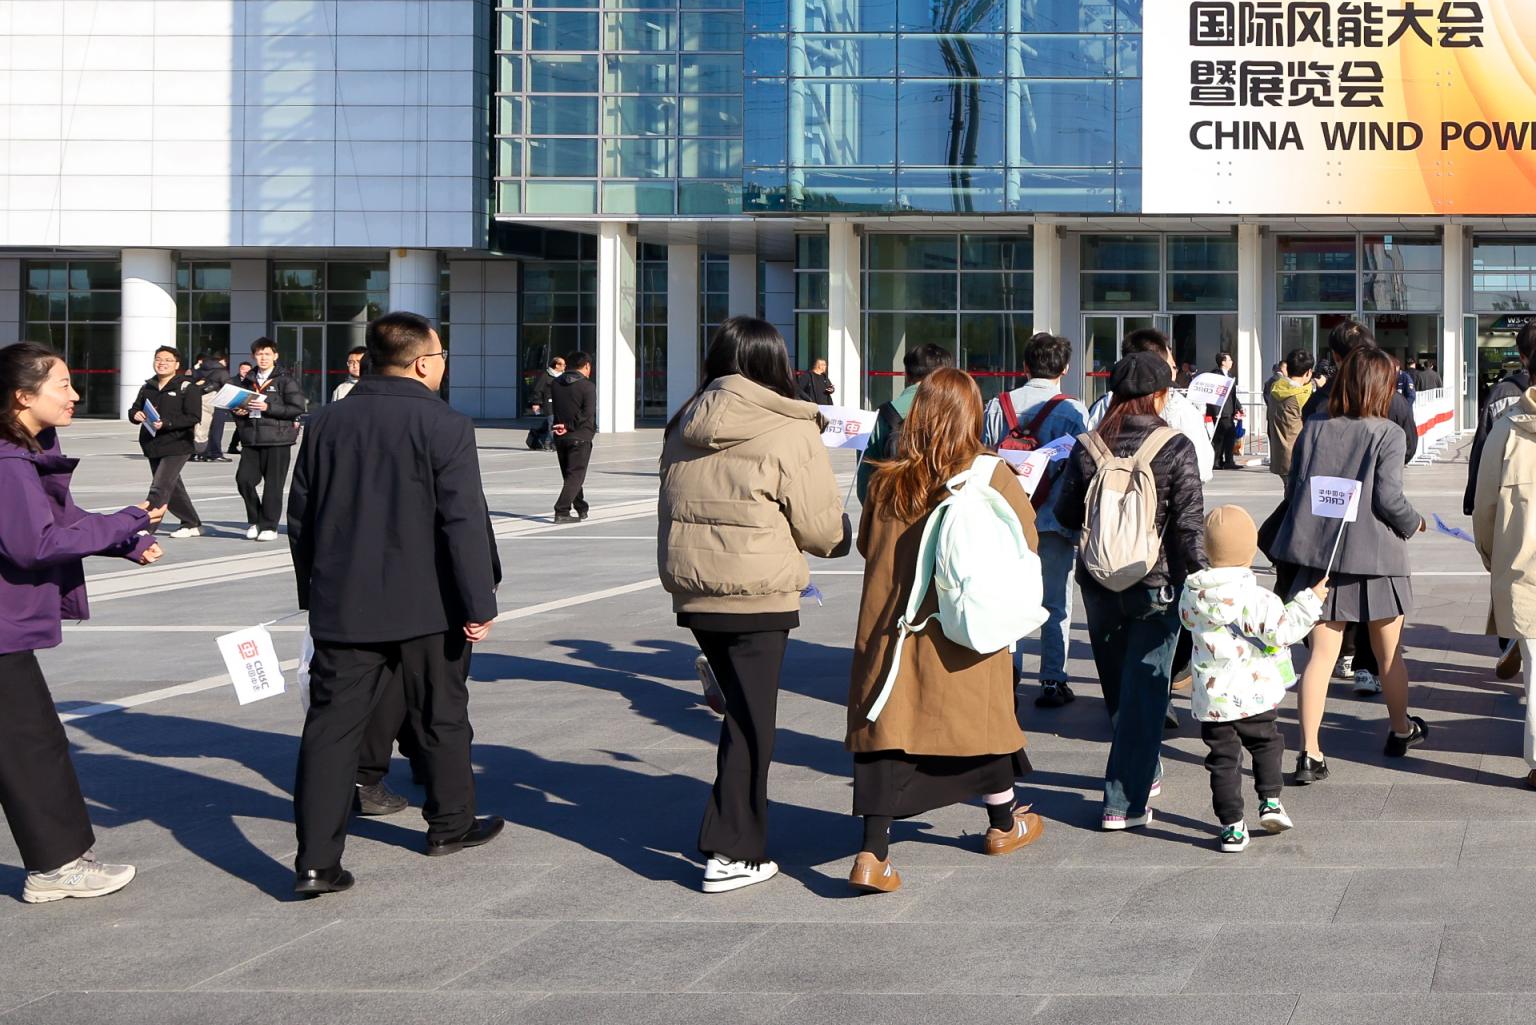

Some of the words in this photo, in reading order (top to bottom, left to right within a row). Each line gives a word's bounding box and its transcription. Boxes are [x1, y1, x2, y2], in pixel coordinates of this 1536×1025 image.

[1189, 1, 1484, 48] 国际风能大会
[1189, 60, 1384, 108] 暨展览会
[1189, 120, 1304, 151] CHINA
[1321, 121, 1423, 151] WIND
